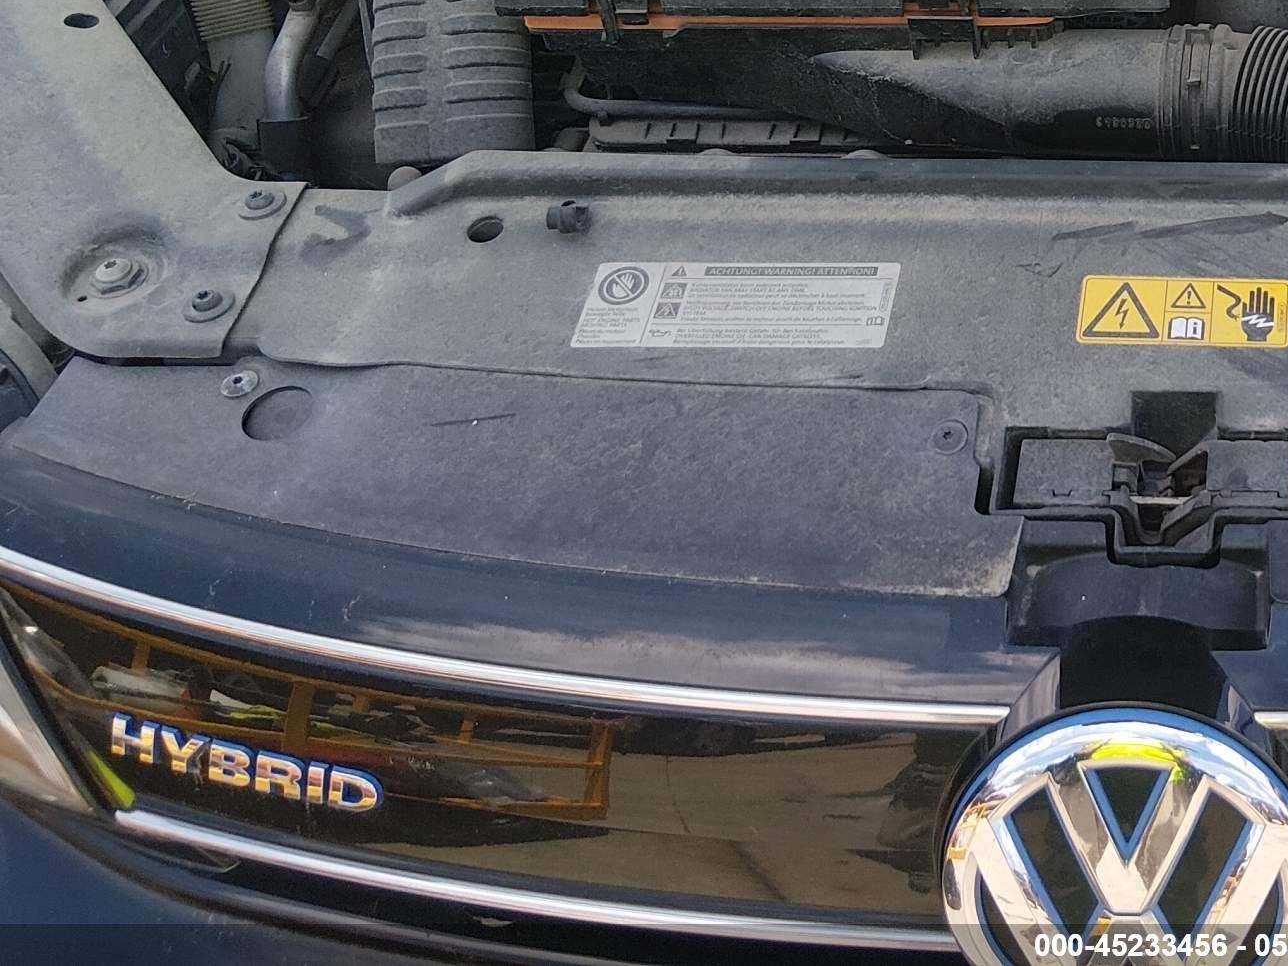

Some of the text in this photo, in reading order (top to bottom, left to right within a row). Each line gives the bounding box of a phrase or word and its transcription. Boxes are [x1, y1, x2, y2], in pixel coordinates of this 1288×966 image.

[709, 267, 876, 275] ACHTUNG! WARNING! ATTENTION!
[110, 712, 385, 812] HYBRID
